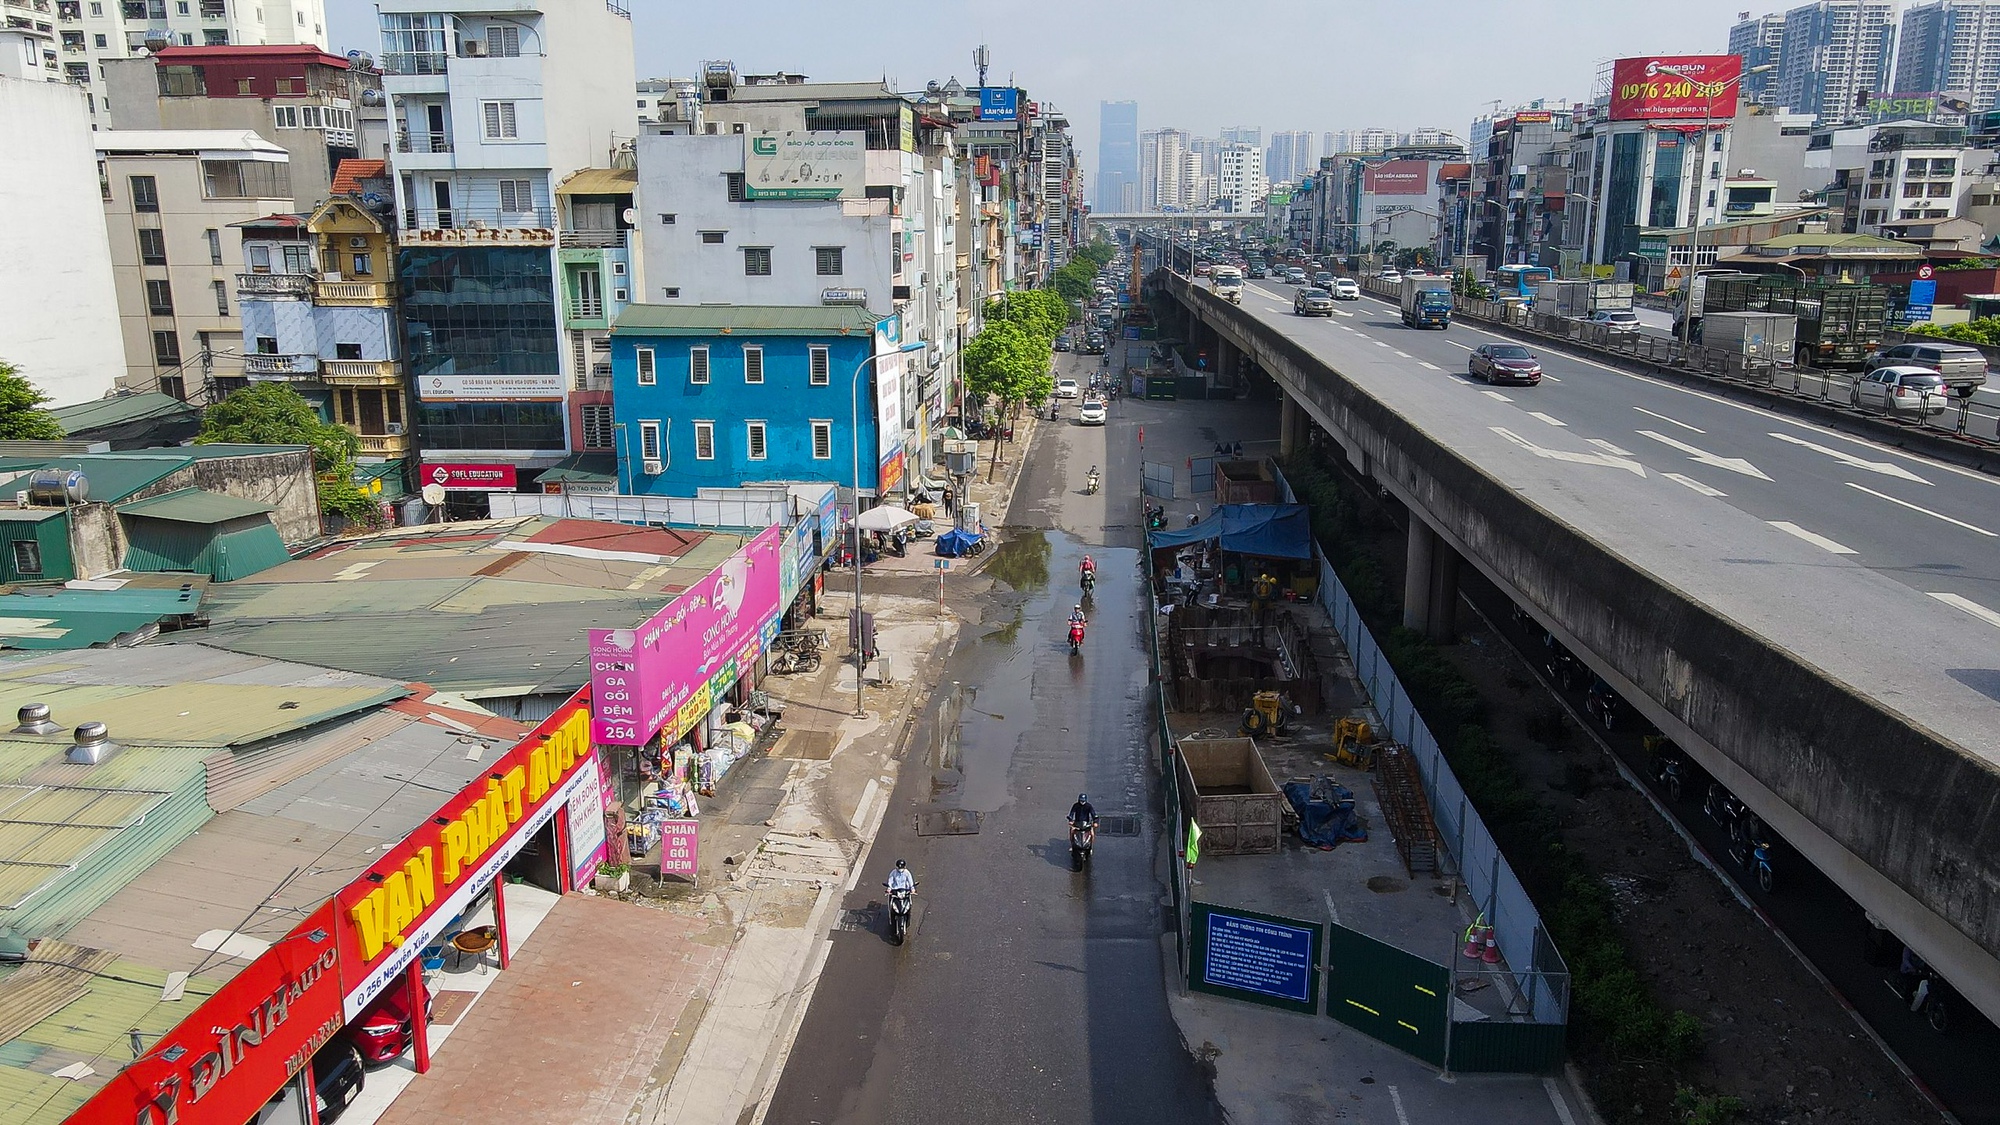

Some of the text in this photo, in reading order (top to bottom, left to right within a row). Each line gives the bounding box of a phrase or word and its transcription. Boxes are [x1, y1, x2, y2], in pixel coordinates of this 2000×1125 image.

[1621, 81, 1725, 100] 0976 240 269
[1869, 98, 1936, 115] FASTER
[451, 470, 503, 478] SOFL EDUCATION
[643, 626, 661, 649] CHĂN
[663, 619, 673, 631] GA
[605, 677, 626, 686] GA
[604, 689, 629, 701] GỐI
[602, 704, 633, 717] ĐỆM
[648, 714, 659, 733] 254
[605, 726, 635, 739] 254
[351, 707, 591, 962] VẠN PHÁT AUTO
[664, 824, 696, 835] CHĂN
[672, 837, 688, 846] GA
[669, 847, 689, 858] GỐI
[666, 859, 692, 872] ĐỆM
[366, 977, 382, 999] 256
[383, 948, 412, 981] Nguyễn
[186, 984, 290, 1105] ĐÌNH
[287, 946, 338, 1006] AUTO
